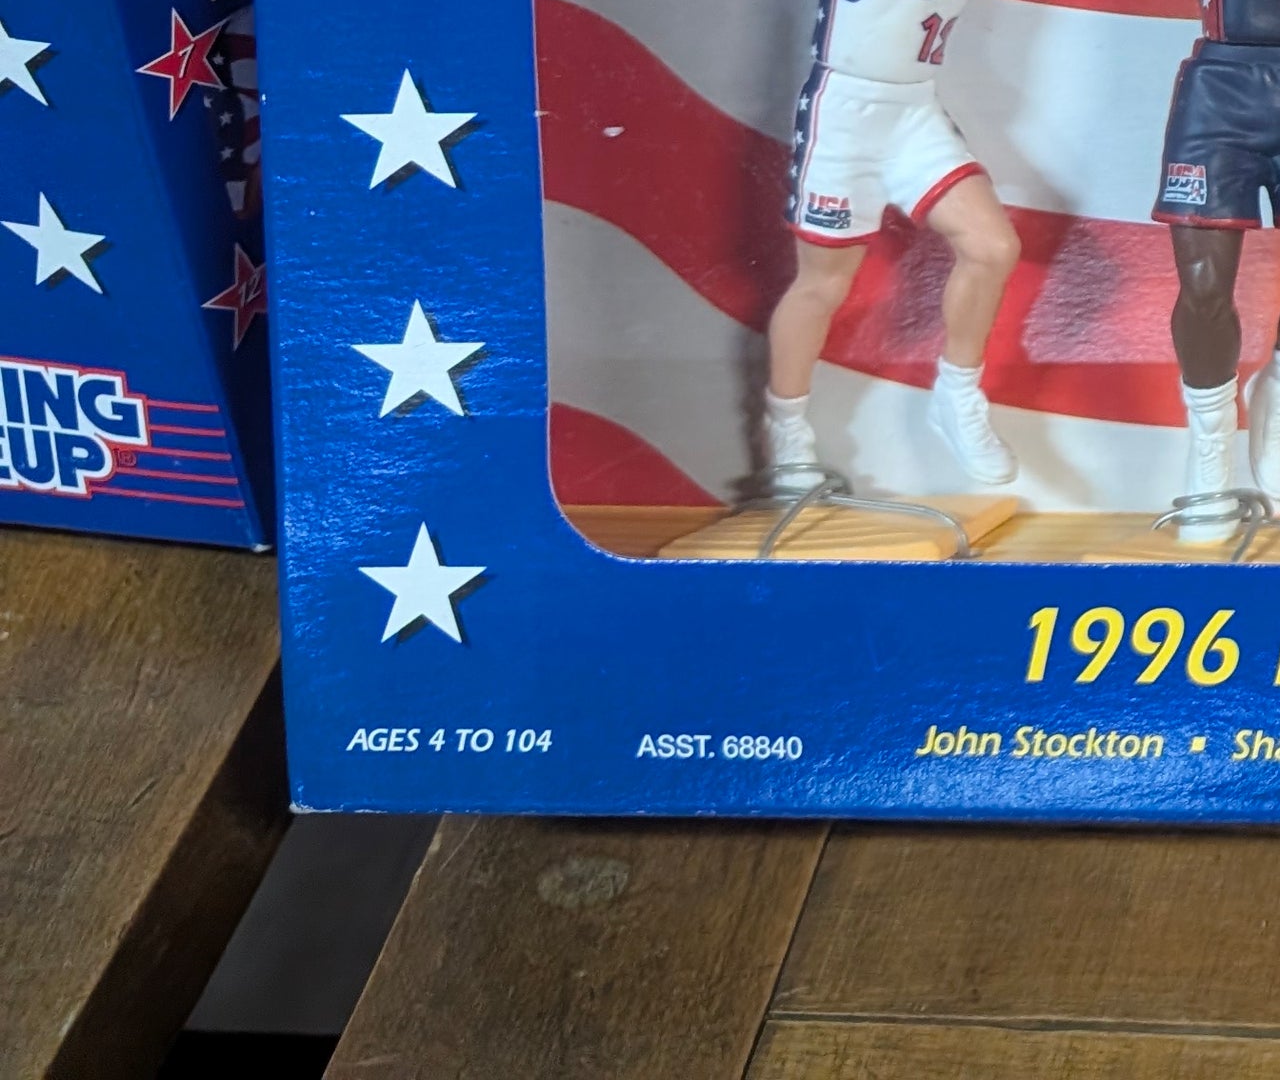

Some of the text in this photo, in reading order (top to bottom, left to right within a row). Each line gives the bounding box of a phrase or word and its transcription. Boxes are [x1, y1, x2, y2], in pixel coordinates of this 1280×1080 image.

[178, 44, 195, 79] 7
[0, 424, 113, 494] UP
[1025, 606, 1241, 686] 1996
[346, 727, 553, 753] AGES 4 TO 104
[637, 733, 804, 761] ASST. 68840
[916, 724, 1164, 758] John Stockton
